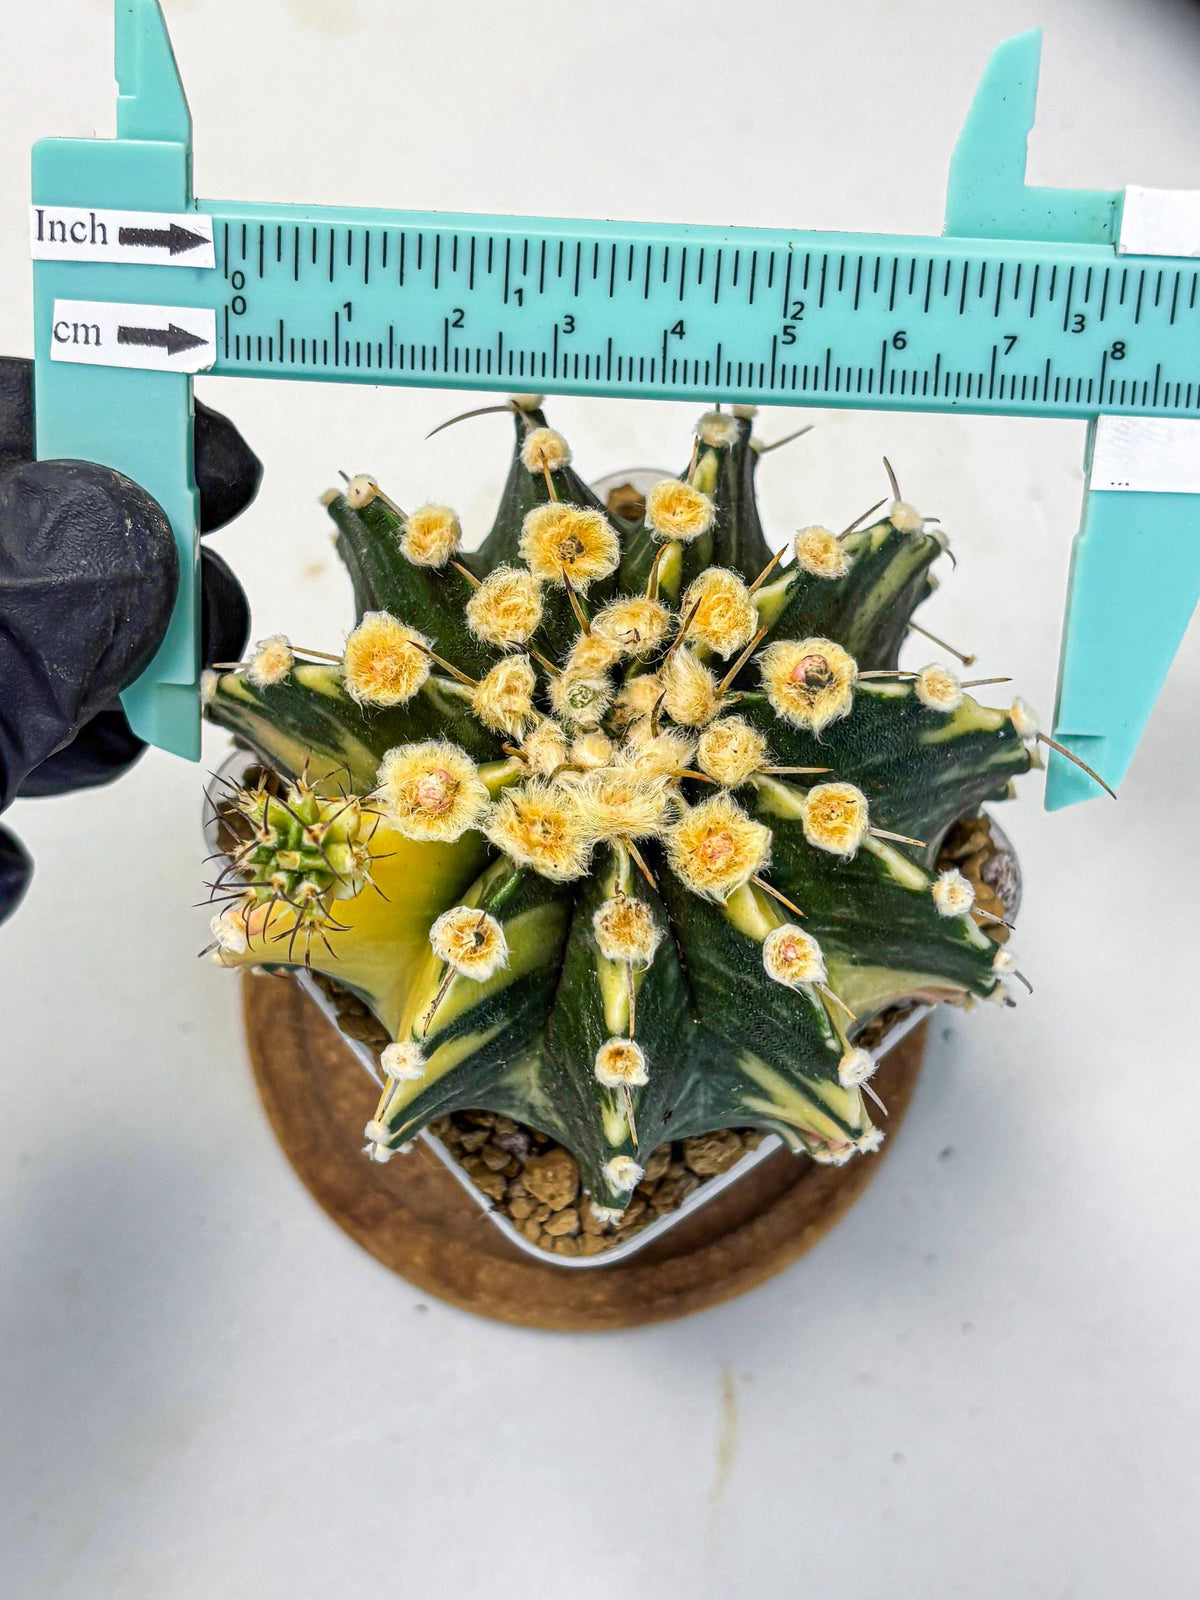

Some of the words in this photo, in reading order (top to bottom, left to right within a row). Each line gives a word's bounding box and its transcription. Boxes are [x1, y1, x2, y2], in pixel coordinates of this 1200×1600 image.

[35, 208, 109, 246] Inch
[231, 270, 246, 291] 0
[513, 287, 524, 308] 1
[790, 300, 805, 321] 2
[1071, 313, 1087, 334] 3
[53, 320, 103, 346] cm
[231, 295, 247, 316] 0
[342, 301, 353, 323] 1
[451, 308, 465, 329] 2
[562, 314, 576, 335] 3
[670, 319, 686, 341] 4
[781, 324, 797, 346] 5
[892, 330, 907, 351] 6
[1002, 335, 1018, 356] 7
[1110, 340, 1126, 361] 8
